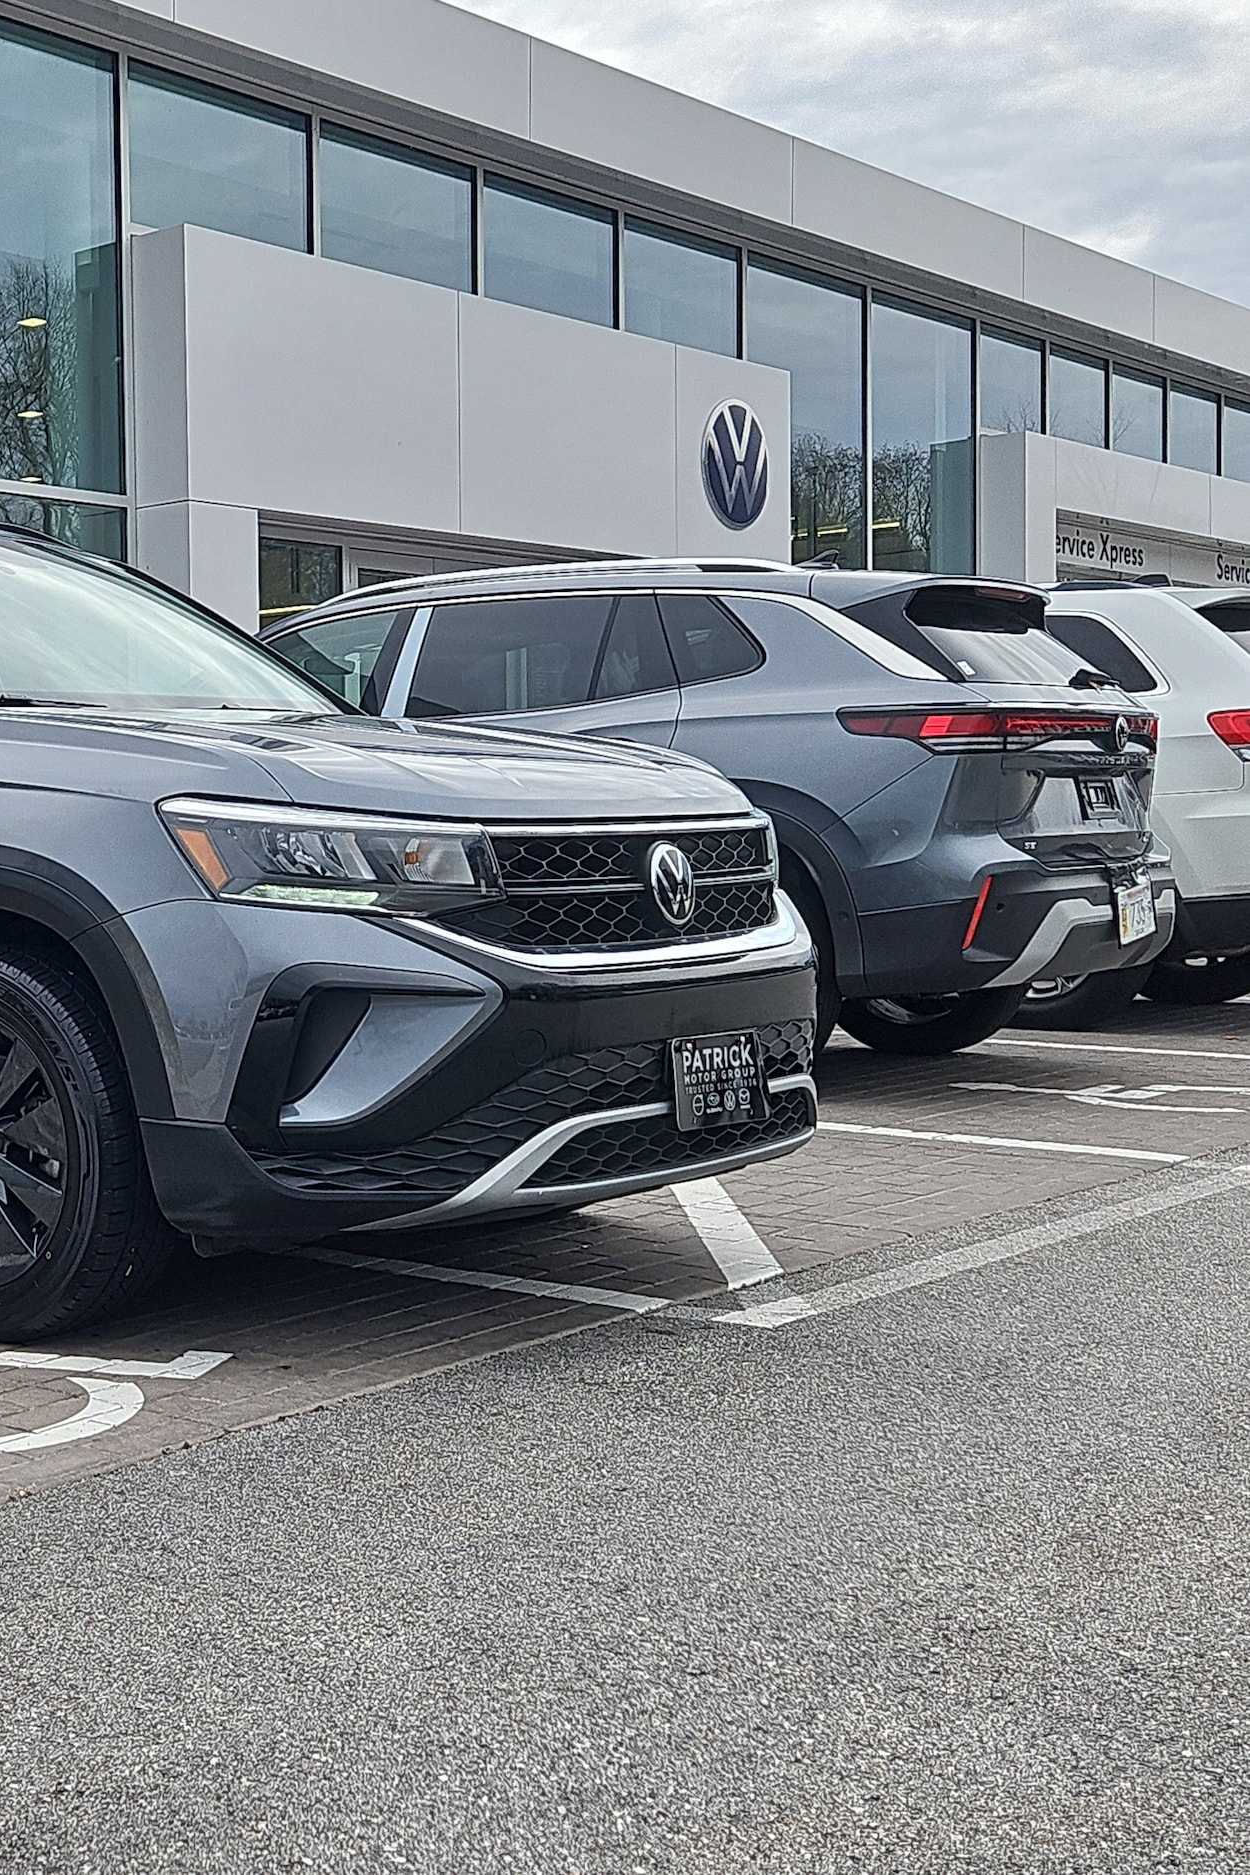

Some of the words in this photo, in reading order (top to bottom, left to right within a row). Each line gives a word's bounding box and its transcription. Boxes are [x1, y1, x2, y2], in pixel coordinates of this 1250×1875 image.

[1056, 529, 1095, 559] ervice
[1100, 533, 1143, 568] Xpress
[682, 1044, 754, 1073] PATRICK
[684, 1071, 717, 1085] MOTOR
[721, 1067, 755, 1080] GROUP
[685, 1084, 715, 1095] TRUSTED
[717, 1080, 738, 1091] SINCE
